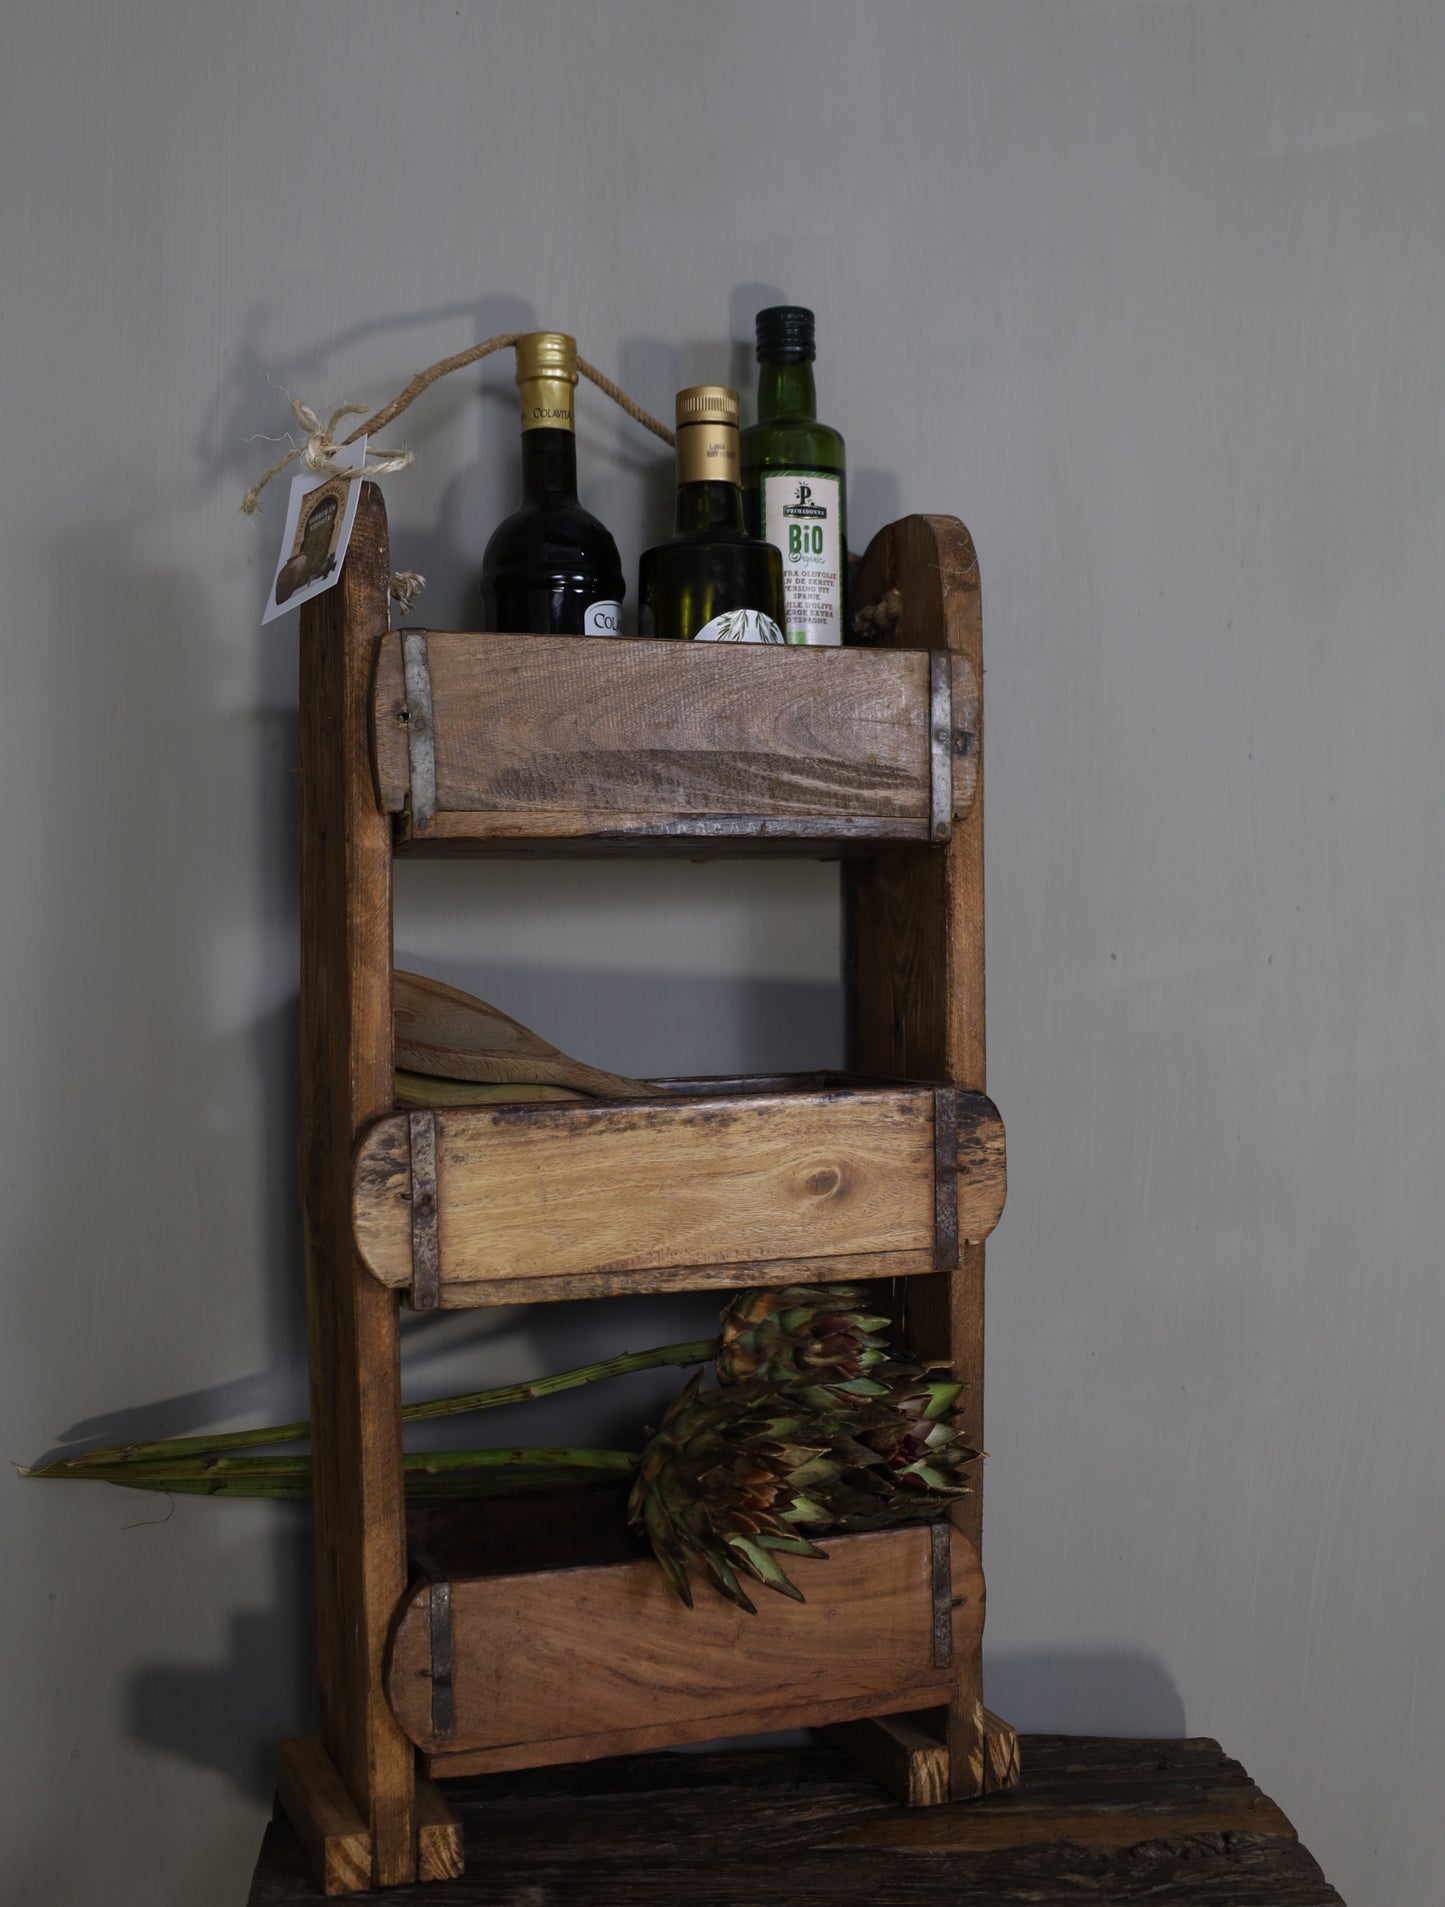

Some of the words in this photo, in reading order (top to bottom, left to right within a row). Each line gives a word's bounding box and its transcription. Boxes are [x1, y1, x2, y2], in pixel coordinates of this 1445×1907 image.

[799, 485, 812, 505] P
[786, 508, 825, 516] PRIMADONNA
[808, 578, 835, 587] EERSTE
[810, 609, 834, 618] EXTRA
